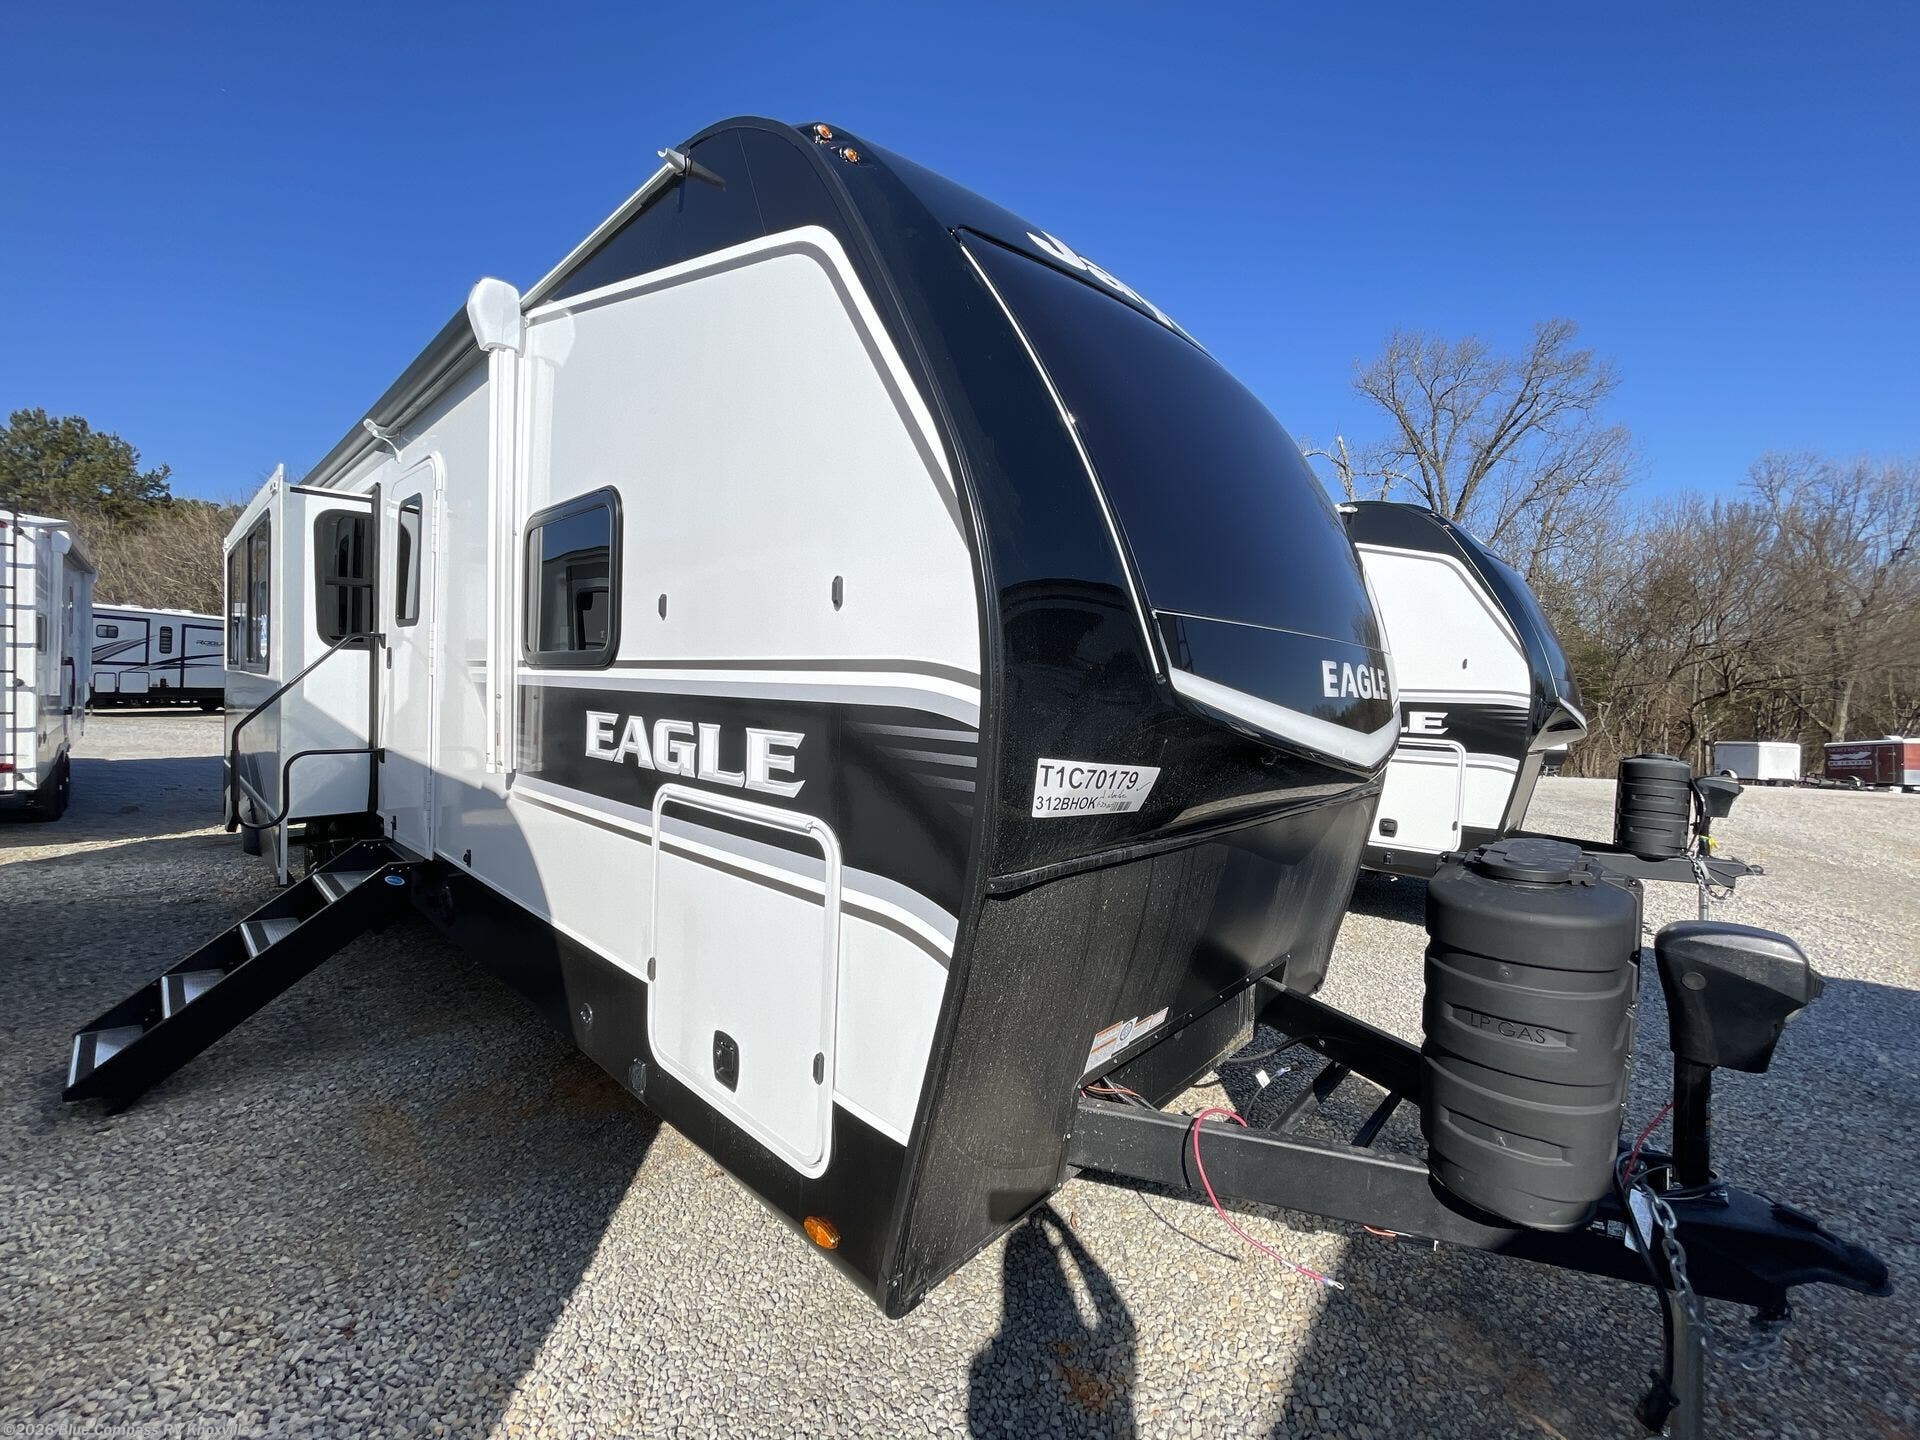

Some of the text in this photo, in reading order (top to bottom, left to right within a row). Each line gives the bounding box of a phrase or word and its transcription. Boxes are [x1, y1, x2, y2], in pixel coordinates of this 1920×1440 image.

[1321, 660, 1389, 701] EAGLE
[585, 710, 806, 798] EAGLE
[1040, 765, 1139, 789] T1C70179
[1035, 795, 1098, 811] 312BHOK
[1469, 1013, 1546, 1044] LP GAS
